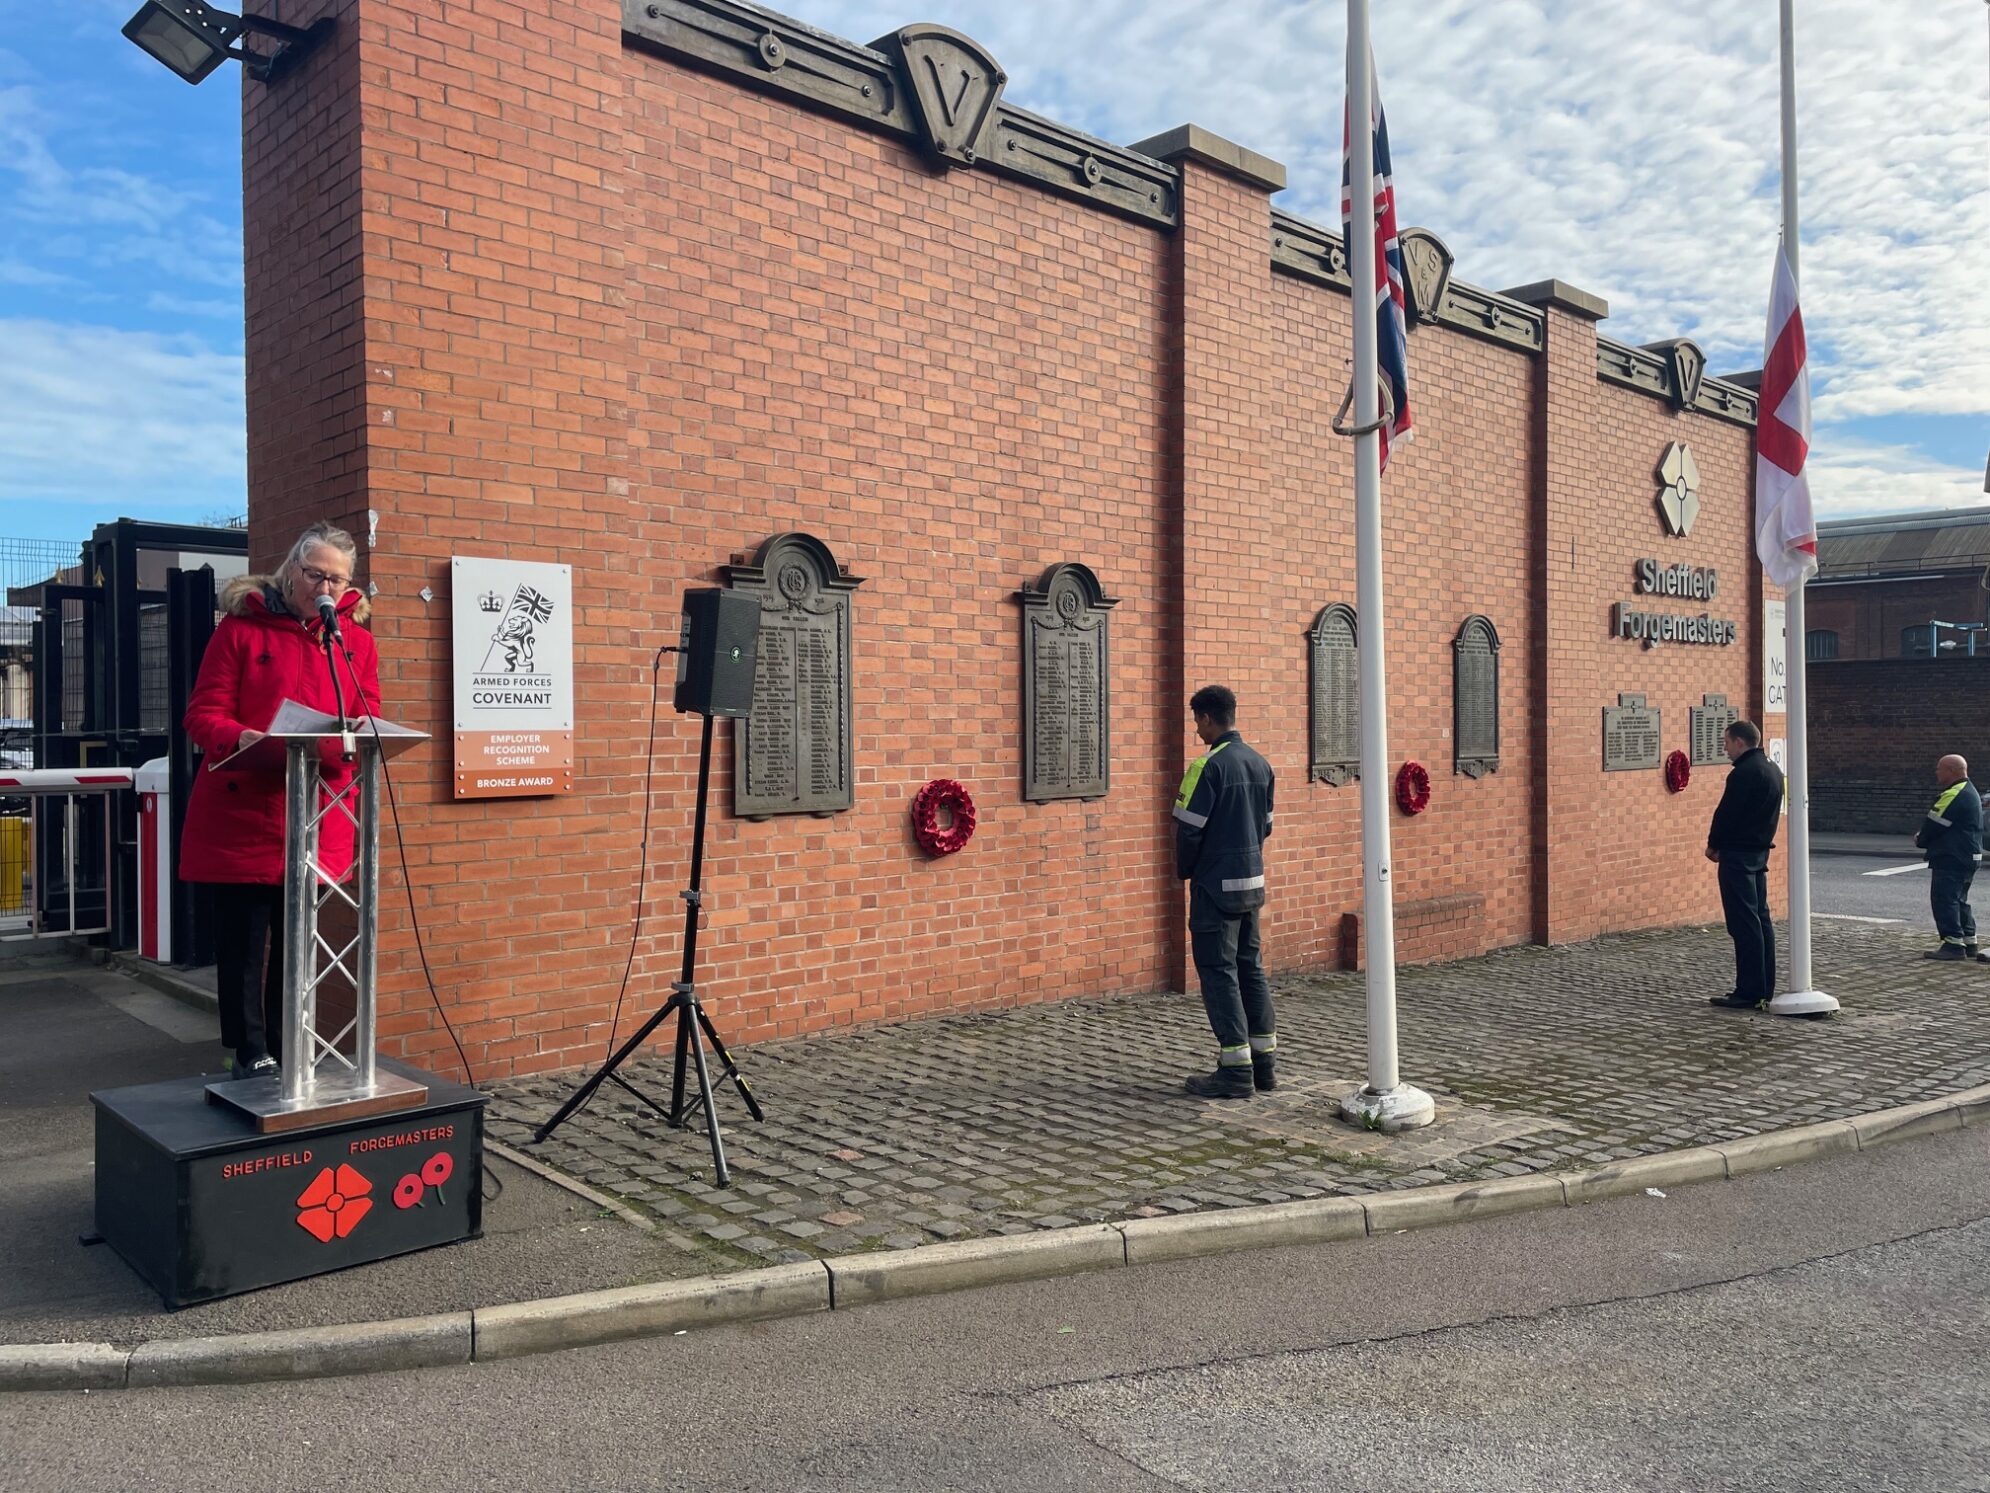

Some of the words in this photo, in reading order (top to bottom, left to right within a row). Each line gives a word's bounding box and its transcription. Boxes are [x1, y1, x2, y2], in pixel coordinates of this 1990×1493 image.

[1637, 558, 1718, 601] Sheffield
[1614, 601, 1737, 648] Forgemasters
[472, 678, 510, 686] ARMED
[513, 678, 552, 687] FORCES
[472, 692, 552, 705] COVENANT
[1768, 685, 1787, 705] GAT
[490, 734, 541, 744] EMPLOYER
[484, 745, 550, 755] RECOGNITION
[496, 756, 535, 766] SCHEME
[477, 779, 516, 788] BRONZE
[518, 777, 553, 787] AWARD
[349, 1125, 454, 1155] FORGEMASTERS
[223, 1151, 312, 1178] SHEFFIELD
